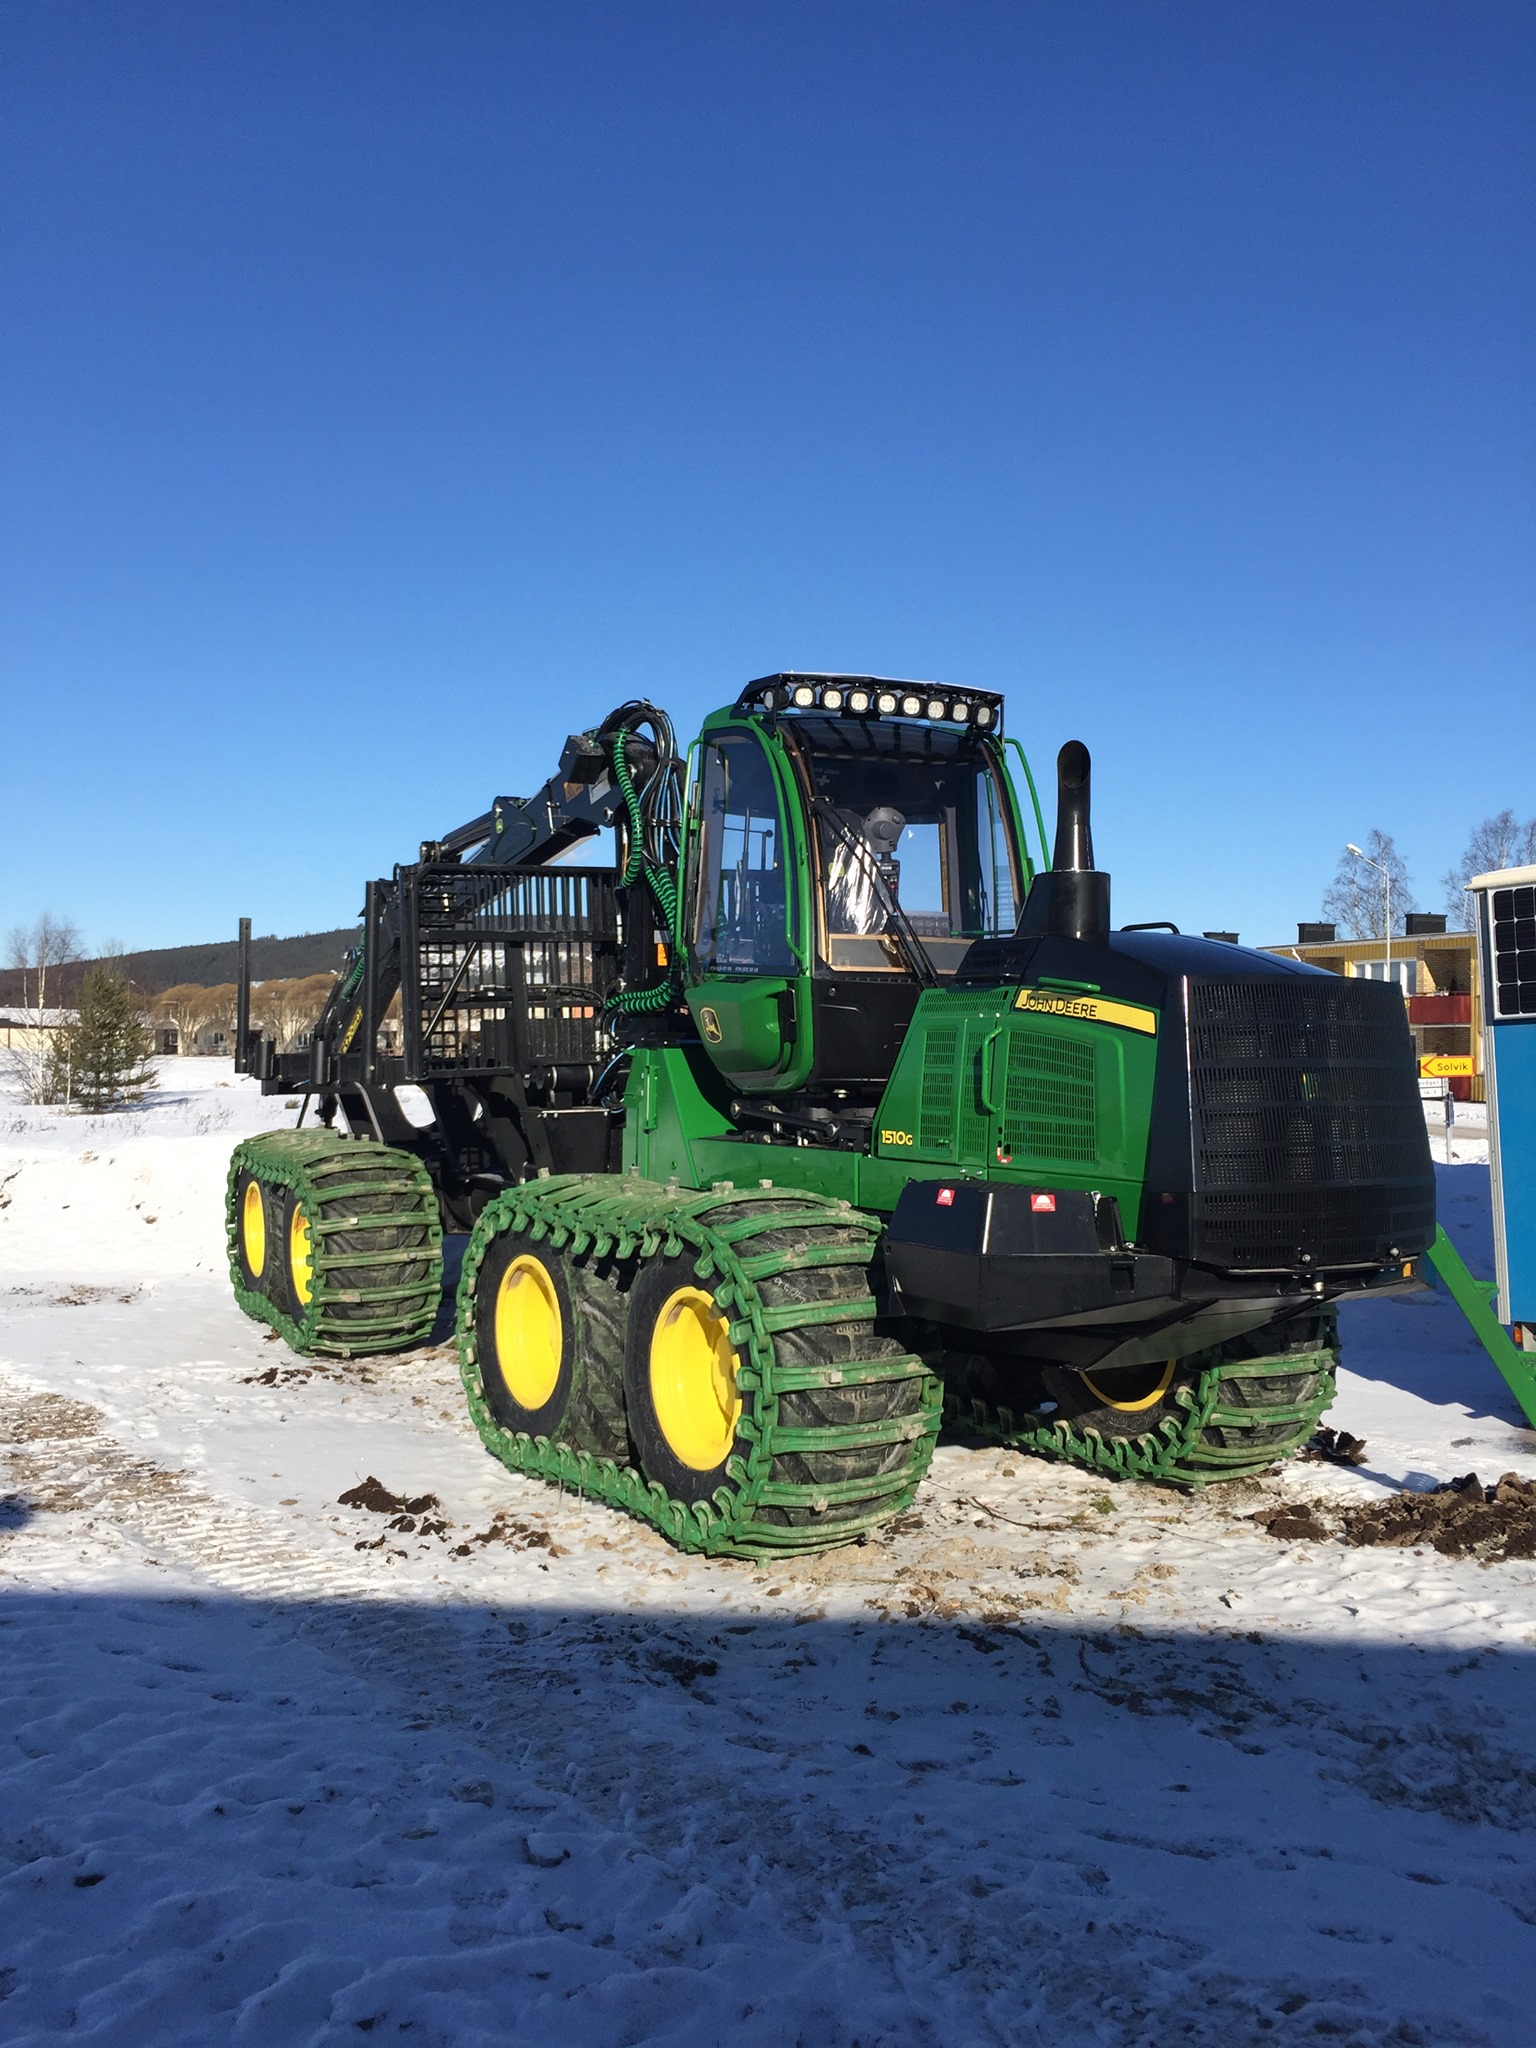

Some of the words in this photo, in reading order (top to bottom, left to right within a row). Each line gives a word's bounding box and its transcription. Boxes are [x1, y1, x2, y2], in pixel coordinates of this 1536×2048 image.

[1021, 993, 1053, 1011] JOHN
[1055, 997, 1097, 1017] DEERE
[1437, 1062, 1468, 1071] Solvik
[881, 1130, 913, 1146] 1510G
